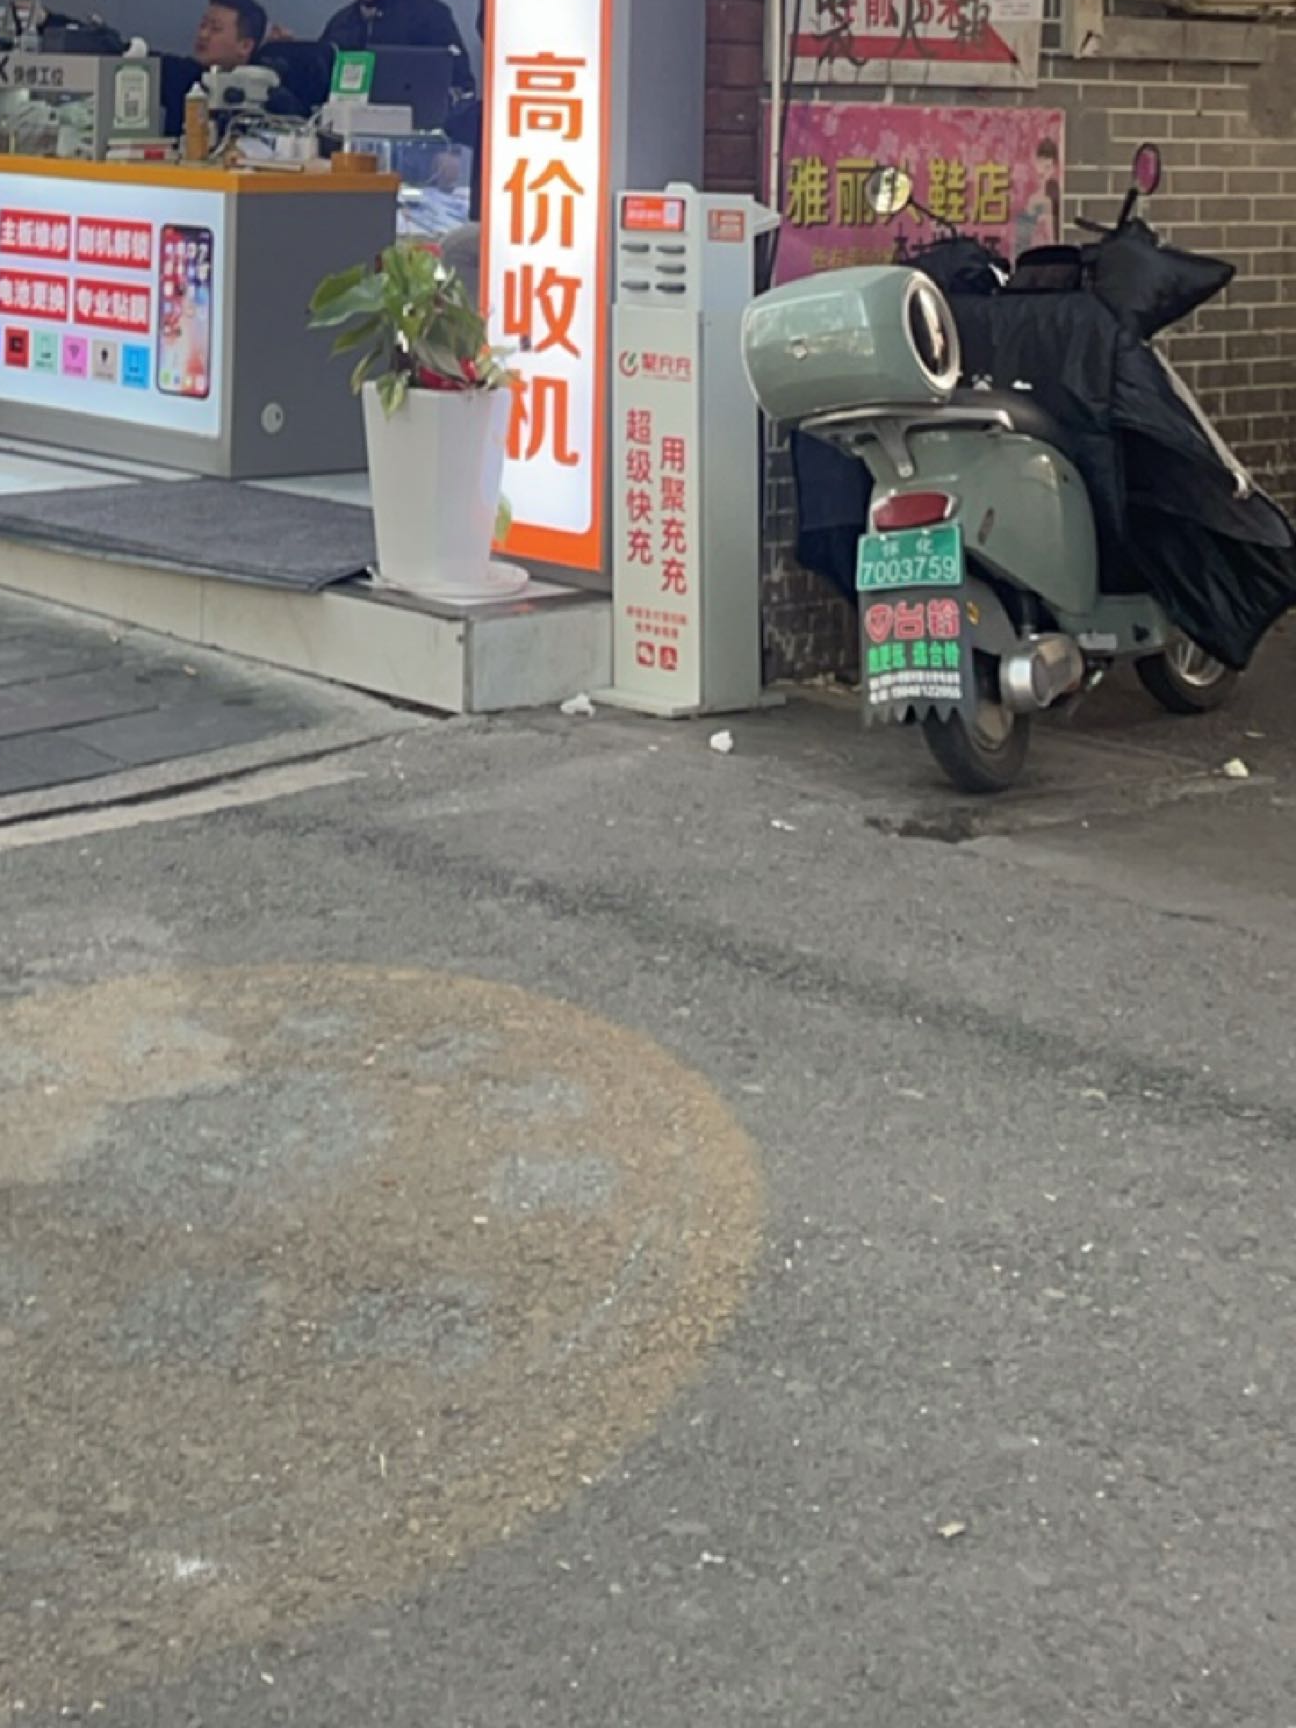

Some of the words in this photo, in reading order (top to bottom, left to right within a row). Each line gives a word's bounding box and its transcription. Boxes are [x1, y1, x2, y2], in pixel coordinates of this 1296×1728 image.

[1, 216, 67, 255] 主板维修
[786, 155, 1010, 226] 雅丽鞋店
[503, 52, 585, 467] 高价收机
[626, 407, 653, 565] 超级快充
[660, 436, 687, 595] 用聚充充
[863, 557, 957, 585] 7003759
